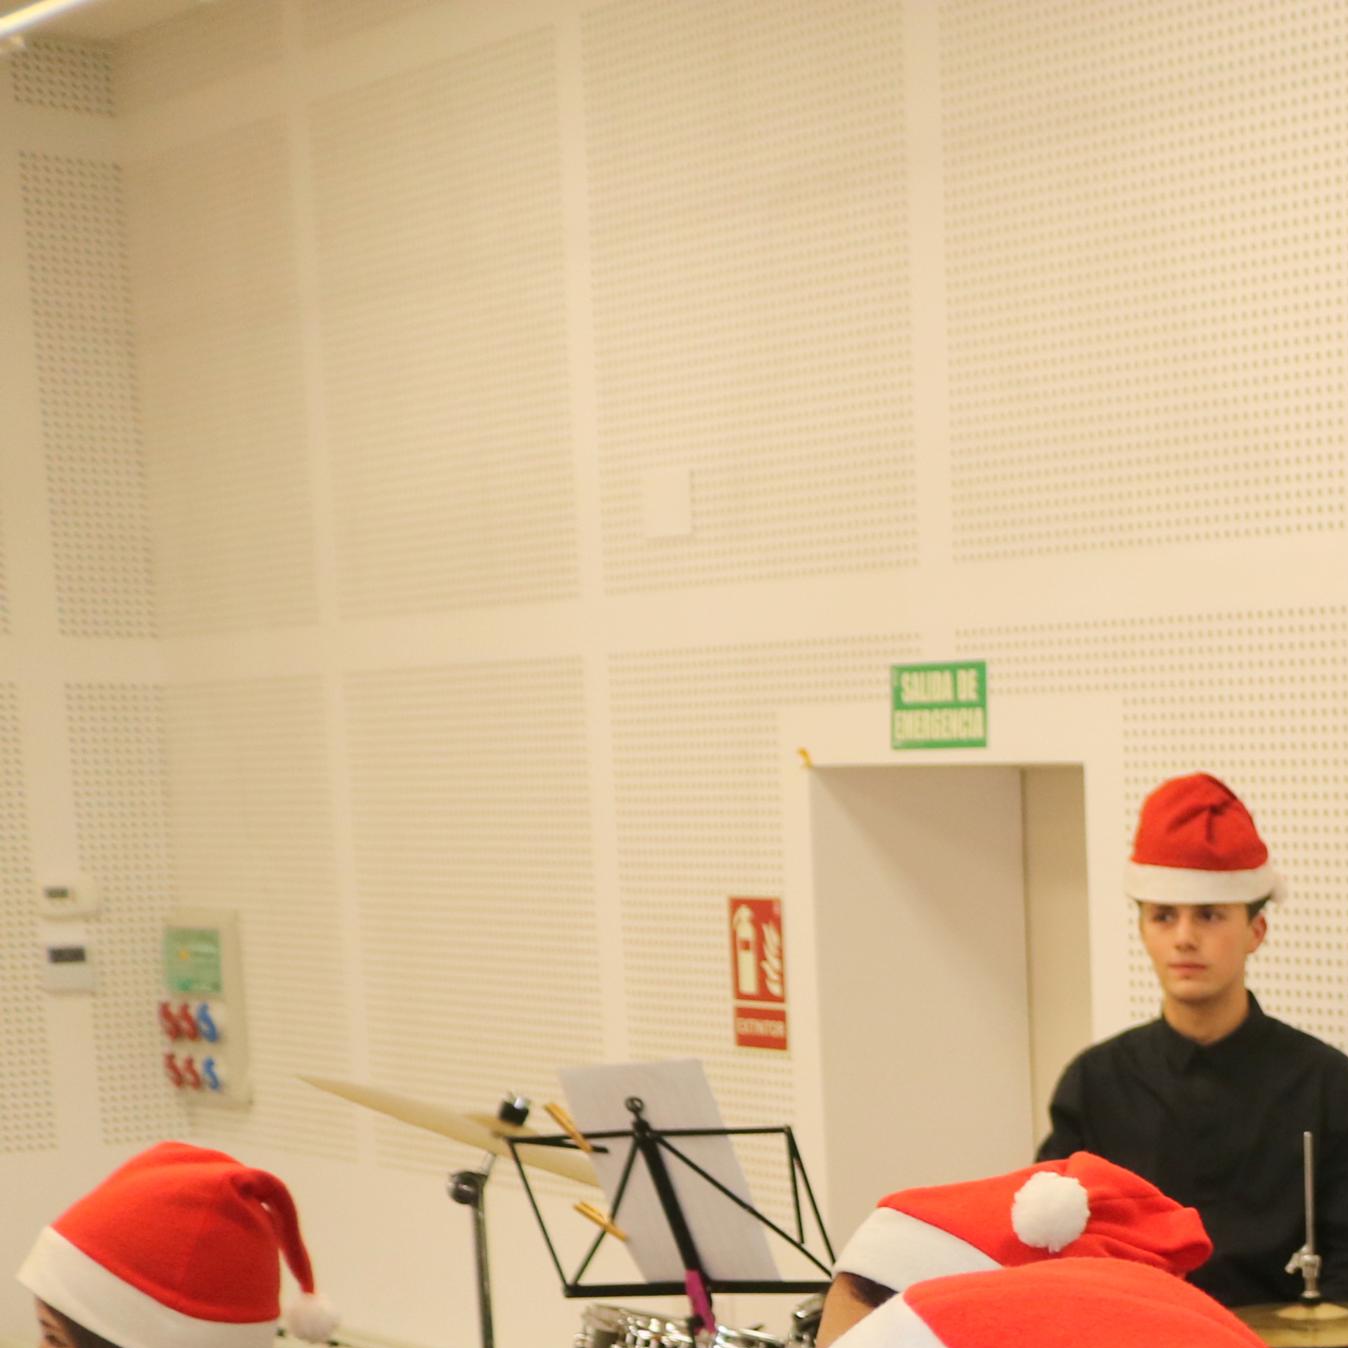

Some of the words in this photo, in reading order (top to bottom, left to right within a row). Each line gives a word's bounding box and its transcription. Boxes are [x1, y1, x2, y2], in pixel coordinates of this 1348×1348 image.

[900, 671, 954, 704] SALIDA
[956, 669, 978, 701] DE
[737, 1017, 785, 1038] EXTINTOR
